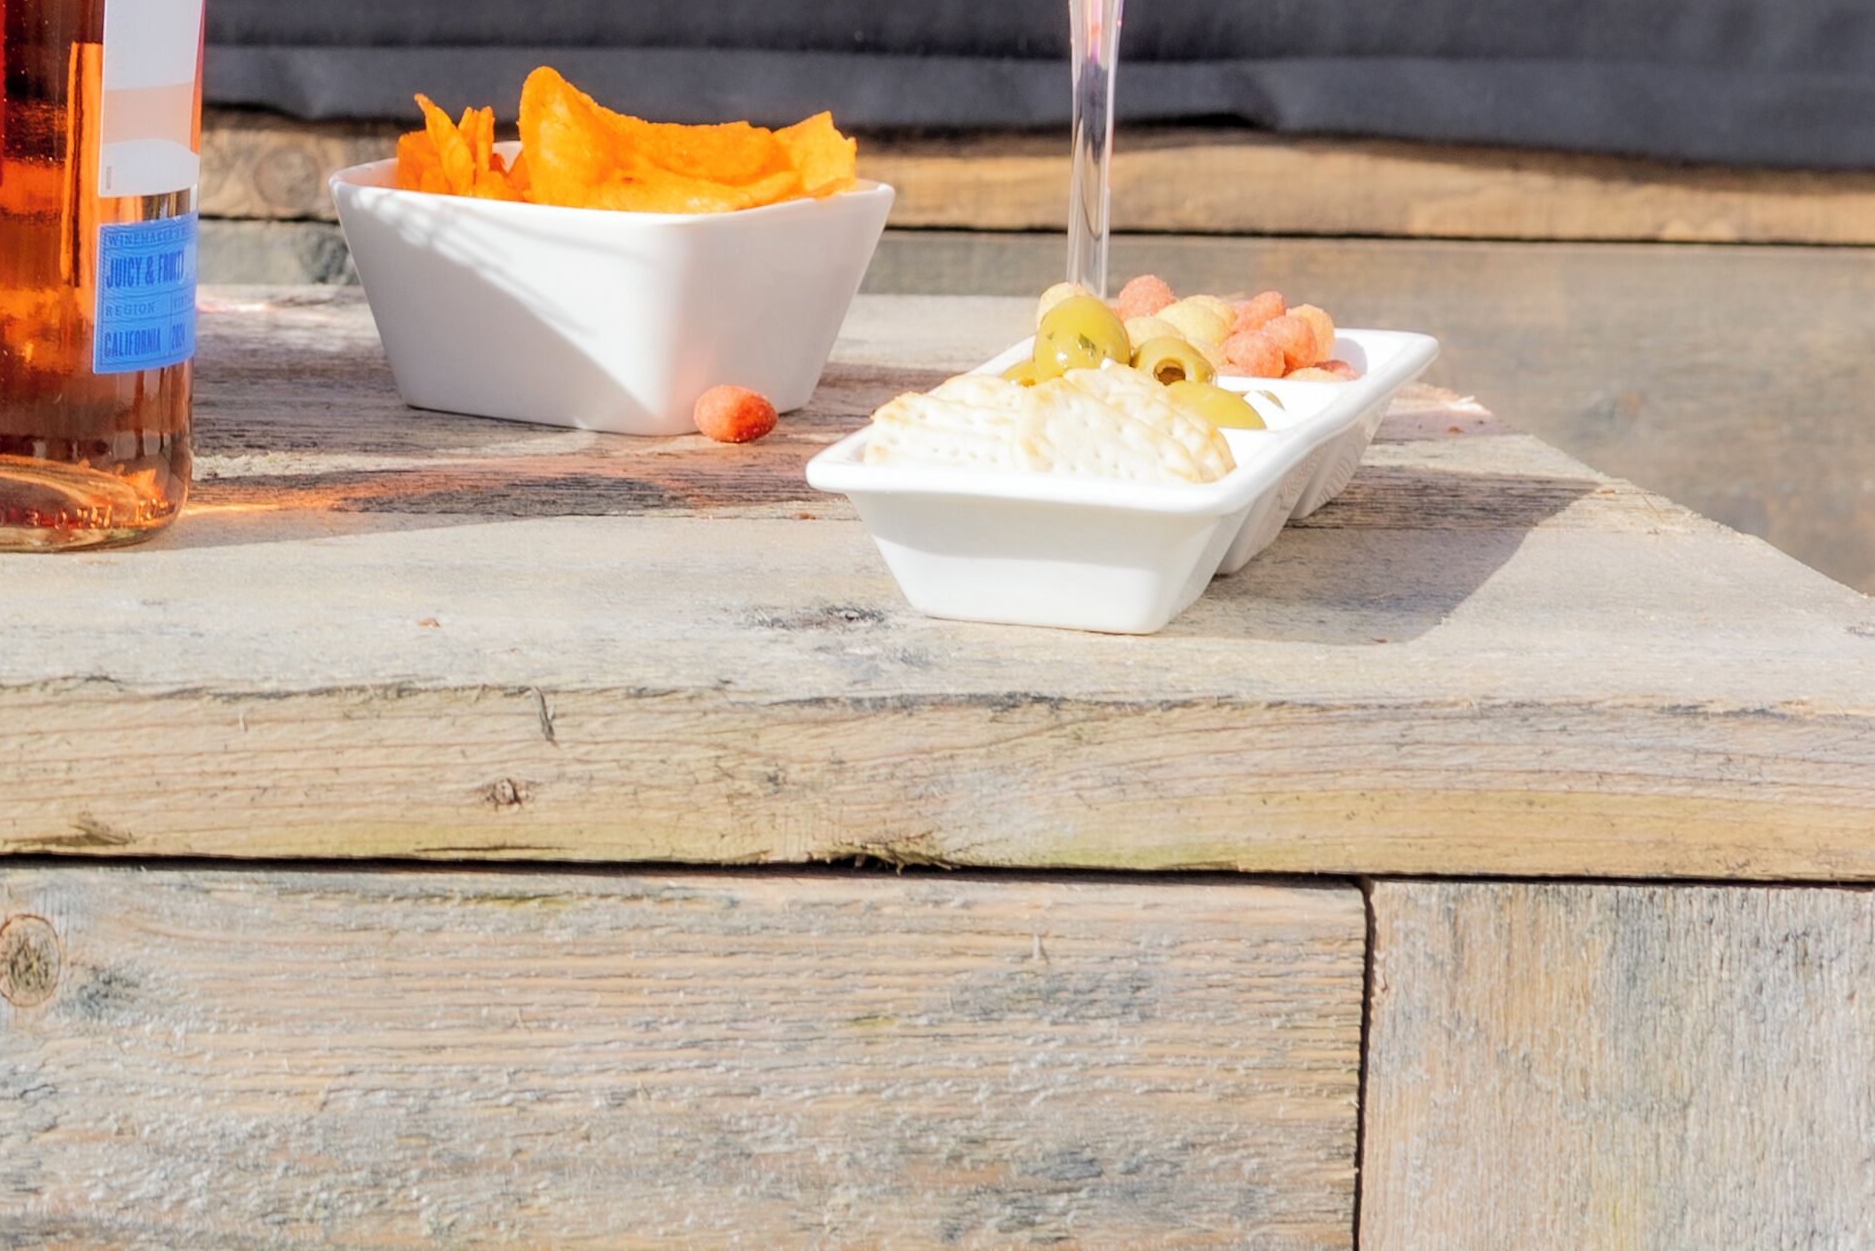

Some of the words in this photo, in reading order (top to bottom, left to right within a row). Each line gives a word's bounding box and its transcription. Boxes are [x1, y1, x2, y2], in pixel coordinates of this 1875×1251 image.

[106, 256, 143, 288] JUICY
[145, 255, 155, 287] &
[105, 301, 155, 318] REGION
[104, 327, 162, 358] CALIFORNIA
